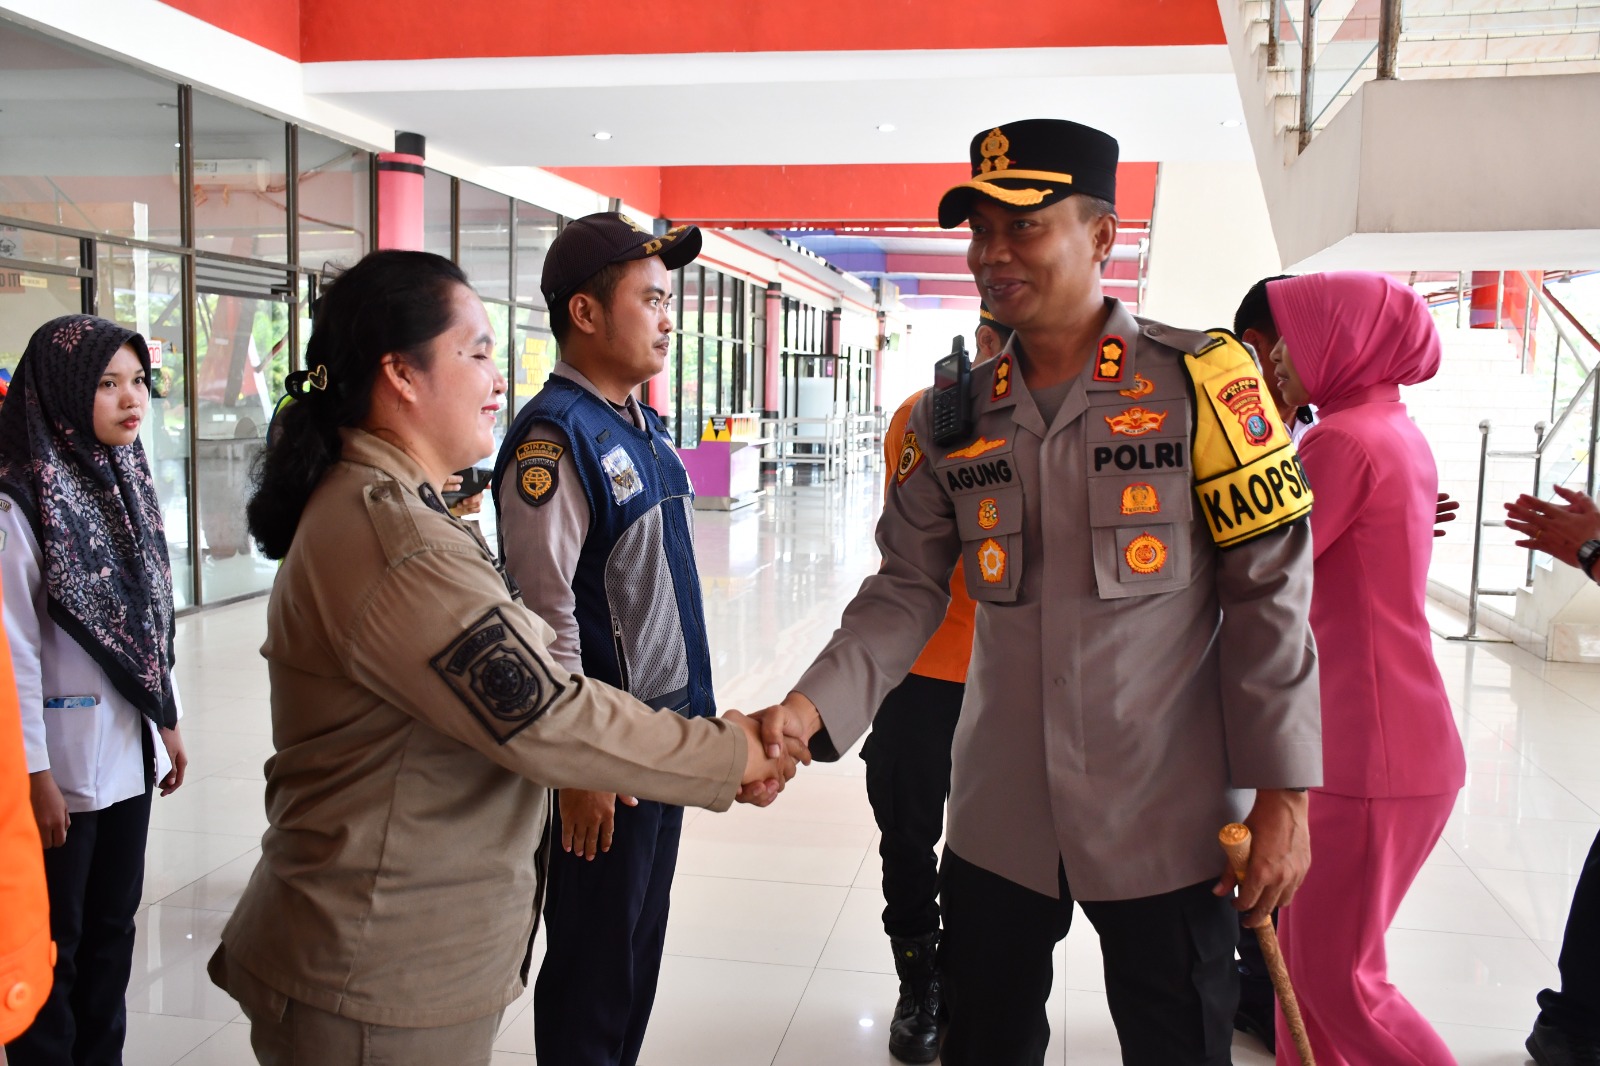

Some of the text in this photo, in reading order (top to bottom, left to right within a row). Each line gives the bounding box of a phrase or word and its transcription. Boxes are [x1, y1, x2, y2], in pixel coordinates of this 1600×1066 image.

[1221, 379, 1257, 400] POLRES
[1231, 385, 1250, 397] NIAS
[523, 444, 553, 452] DINAS
[1094, 442, 1183, 472] POLRI
[946, 459, 1012, 492] AGUNG
